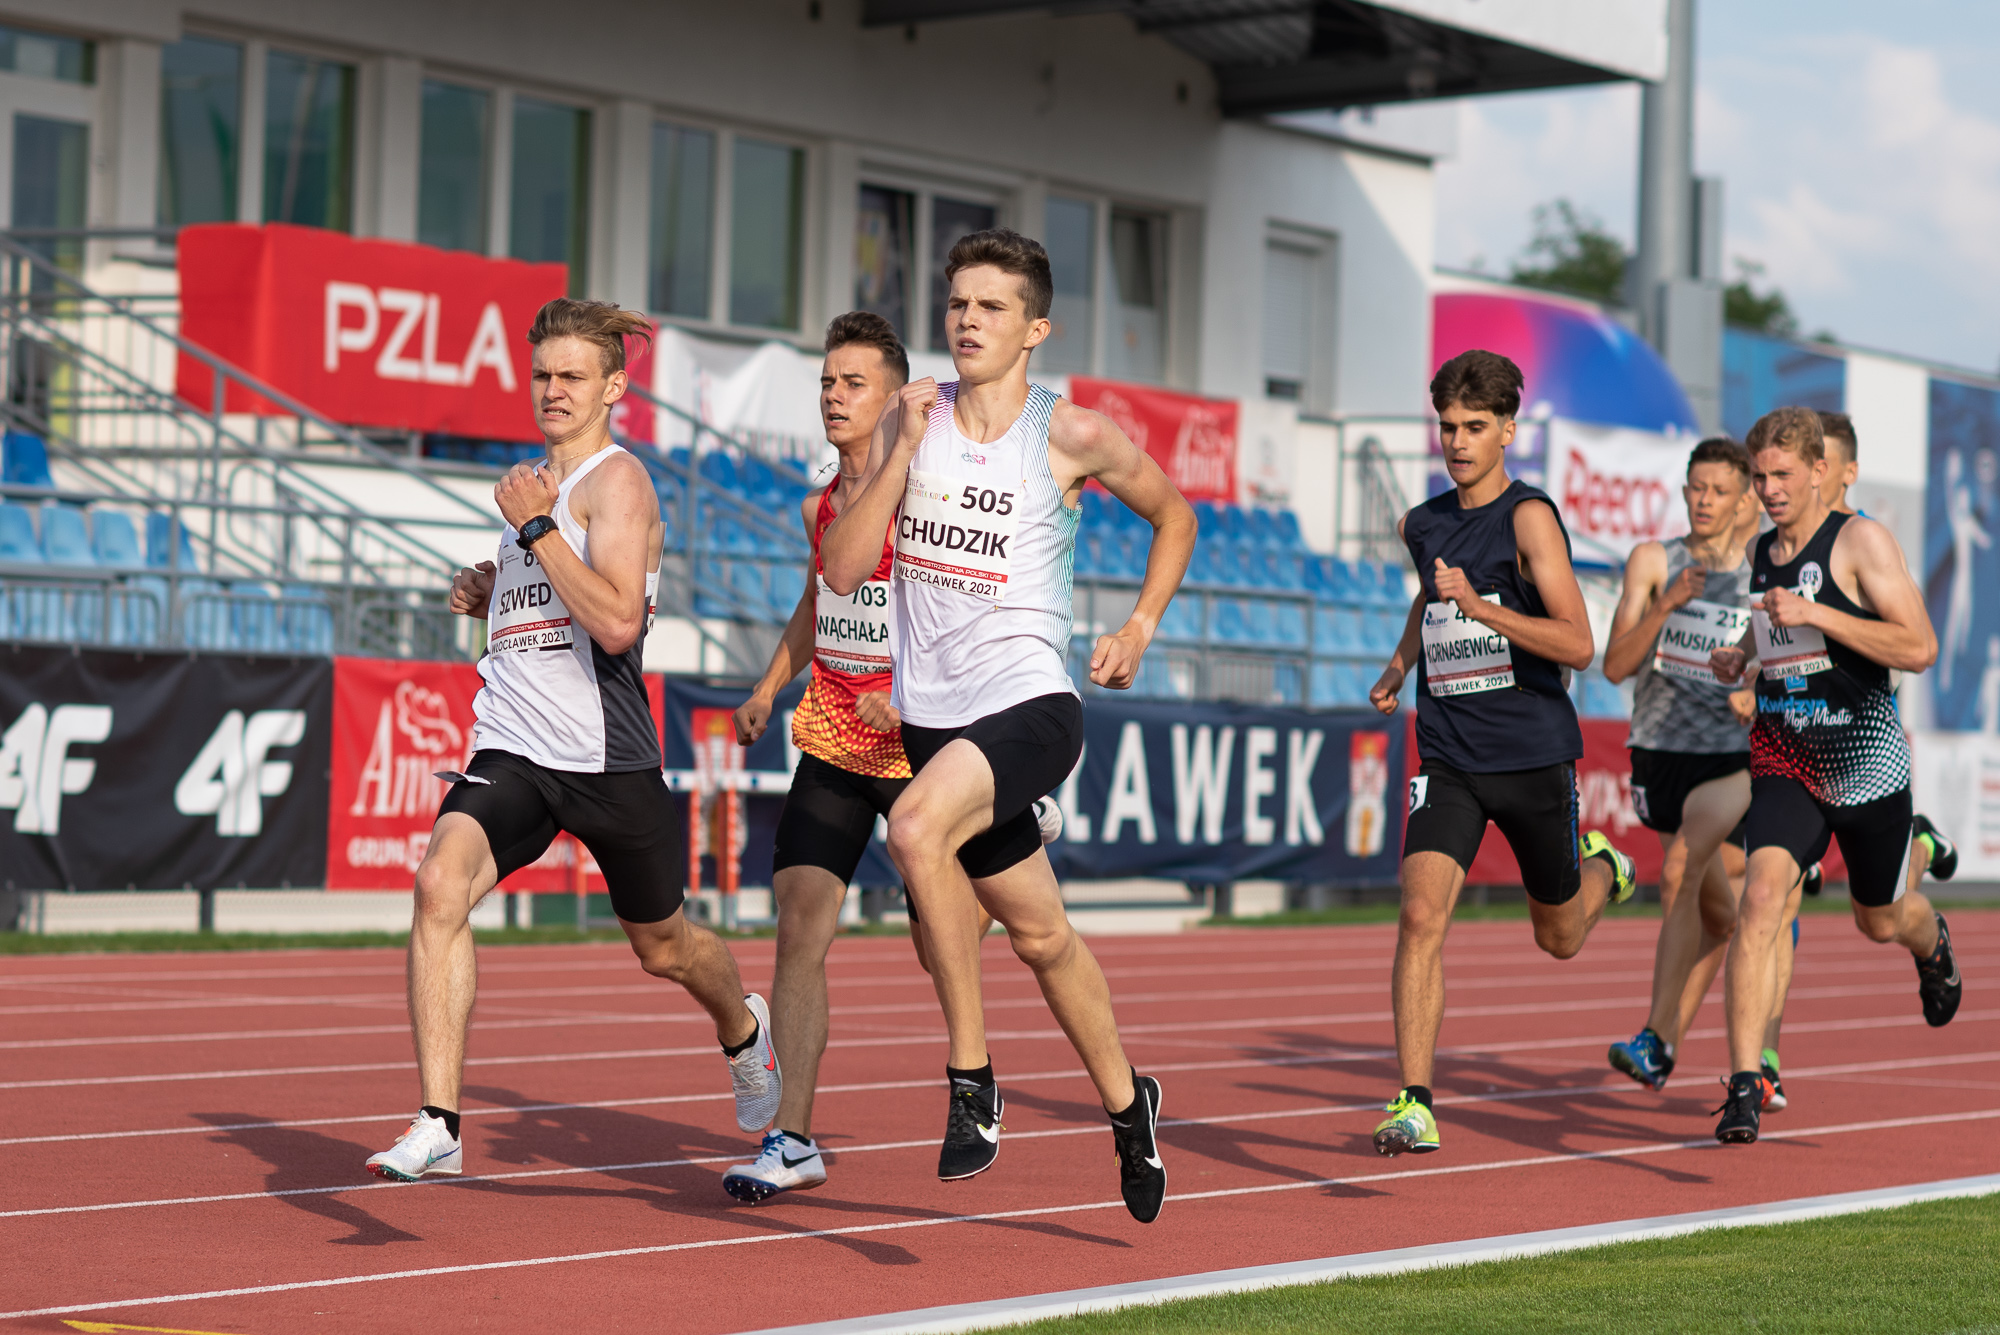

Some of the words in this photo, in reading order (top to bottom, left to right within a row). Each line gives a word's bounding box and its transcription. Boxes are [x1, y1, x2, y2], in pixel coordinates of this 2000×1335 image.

[325, 280, 517, 392] PZLA
[960, 485, 1014, 516] 505
[901, 515, 1010, 559] CHUDZIK
[899, 564, 966, 591] WŁOCŁAWEK
[969, 581, 998, 597] 2021
[920, 560, 964, 575] MISTRZOSTWA
[965, 569, 989, 579] POLSKI
[499, 582, 552, 616] SZWED
[491, 633, 539, 655] WŁOCŁAWEK
[541, 630, 566, 645] 2021
[816, 613, 889, 643] WĄCHAŁA
[1665, 627, 1736, 653] MUSIA
[1426, 634, 1506, 664] KORNASIEWICZ
[1803, 659, 1826, 673] 2021
[1484, 675, 1509, 688] 2021
[1758, 695, 1828, 717] Kwidzyn
[1784, 708, 1810, 734] Moje
[1812, 706, 1854, 727] Miasto
[0, 702, 113, 836] 4F
[174, 709, 307, 837] 4F
